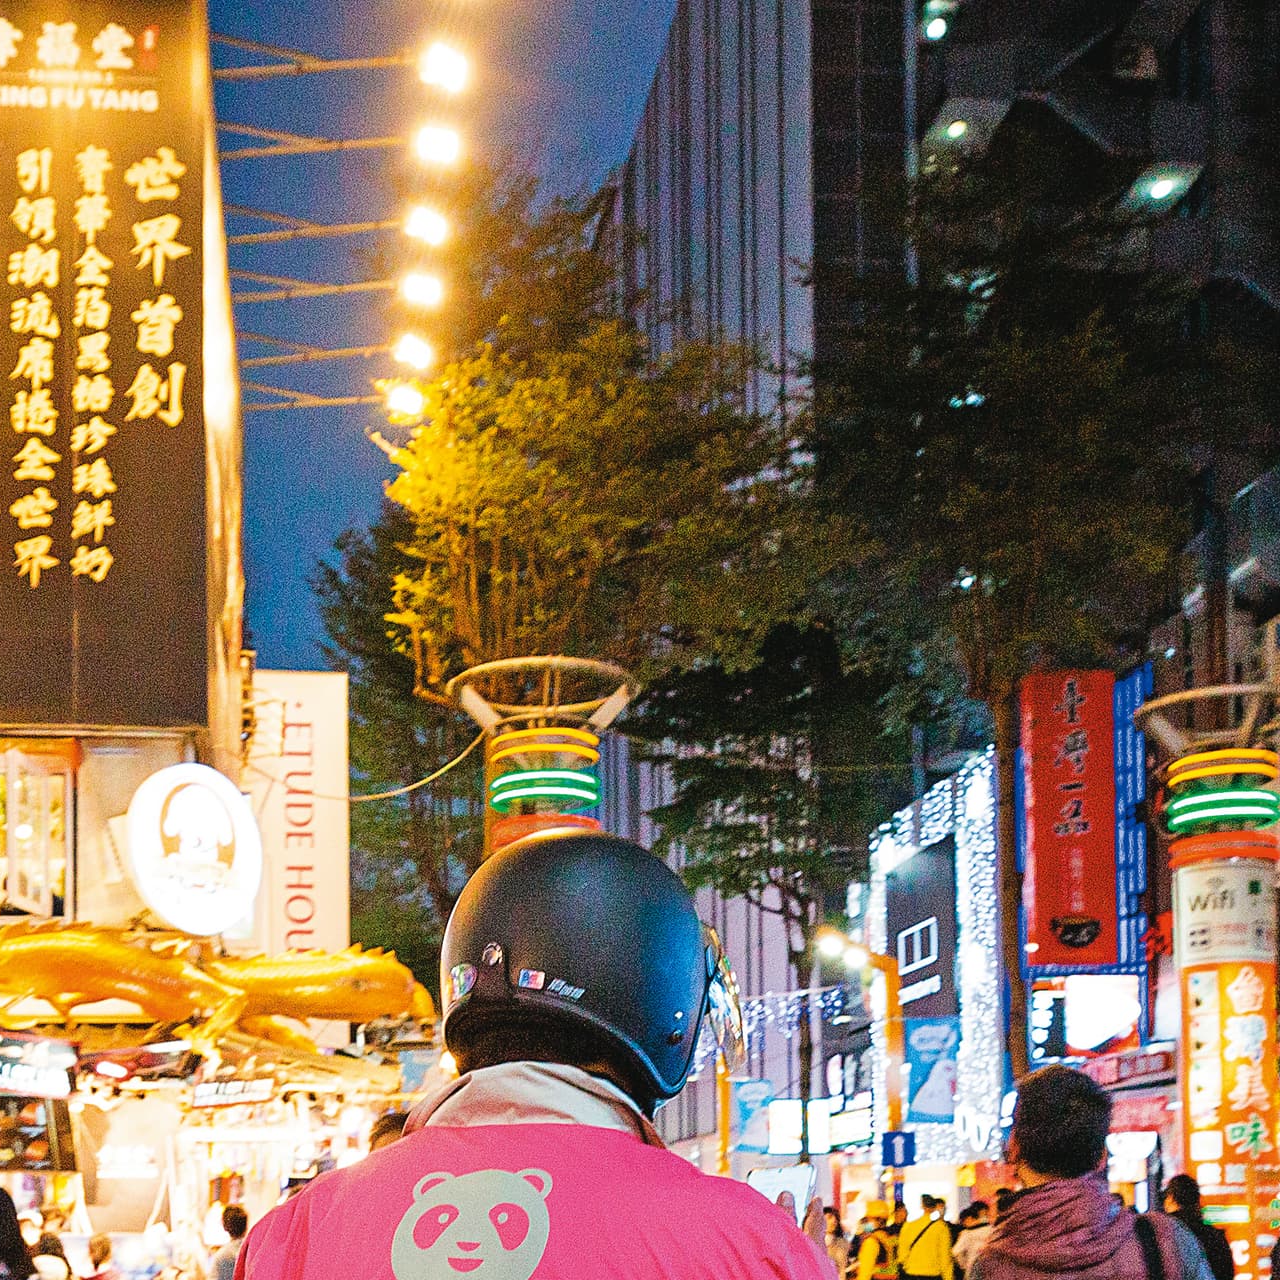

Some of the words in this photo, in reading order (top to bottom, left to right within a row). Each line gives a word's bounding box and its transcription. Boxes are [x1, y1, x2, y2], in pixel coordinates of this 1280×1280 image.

[51, 87, 84, 110] FU
[88, 89, 159, 113] TANG
[123, 146, 192, 429] 世界首創
[7, 146, 62, 590] 引領潮流席捲全世界
[283, 722, 315, 849] ETUDE
[284, 865, 315, 954] HOU
